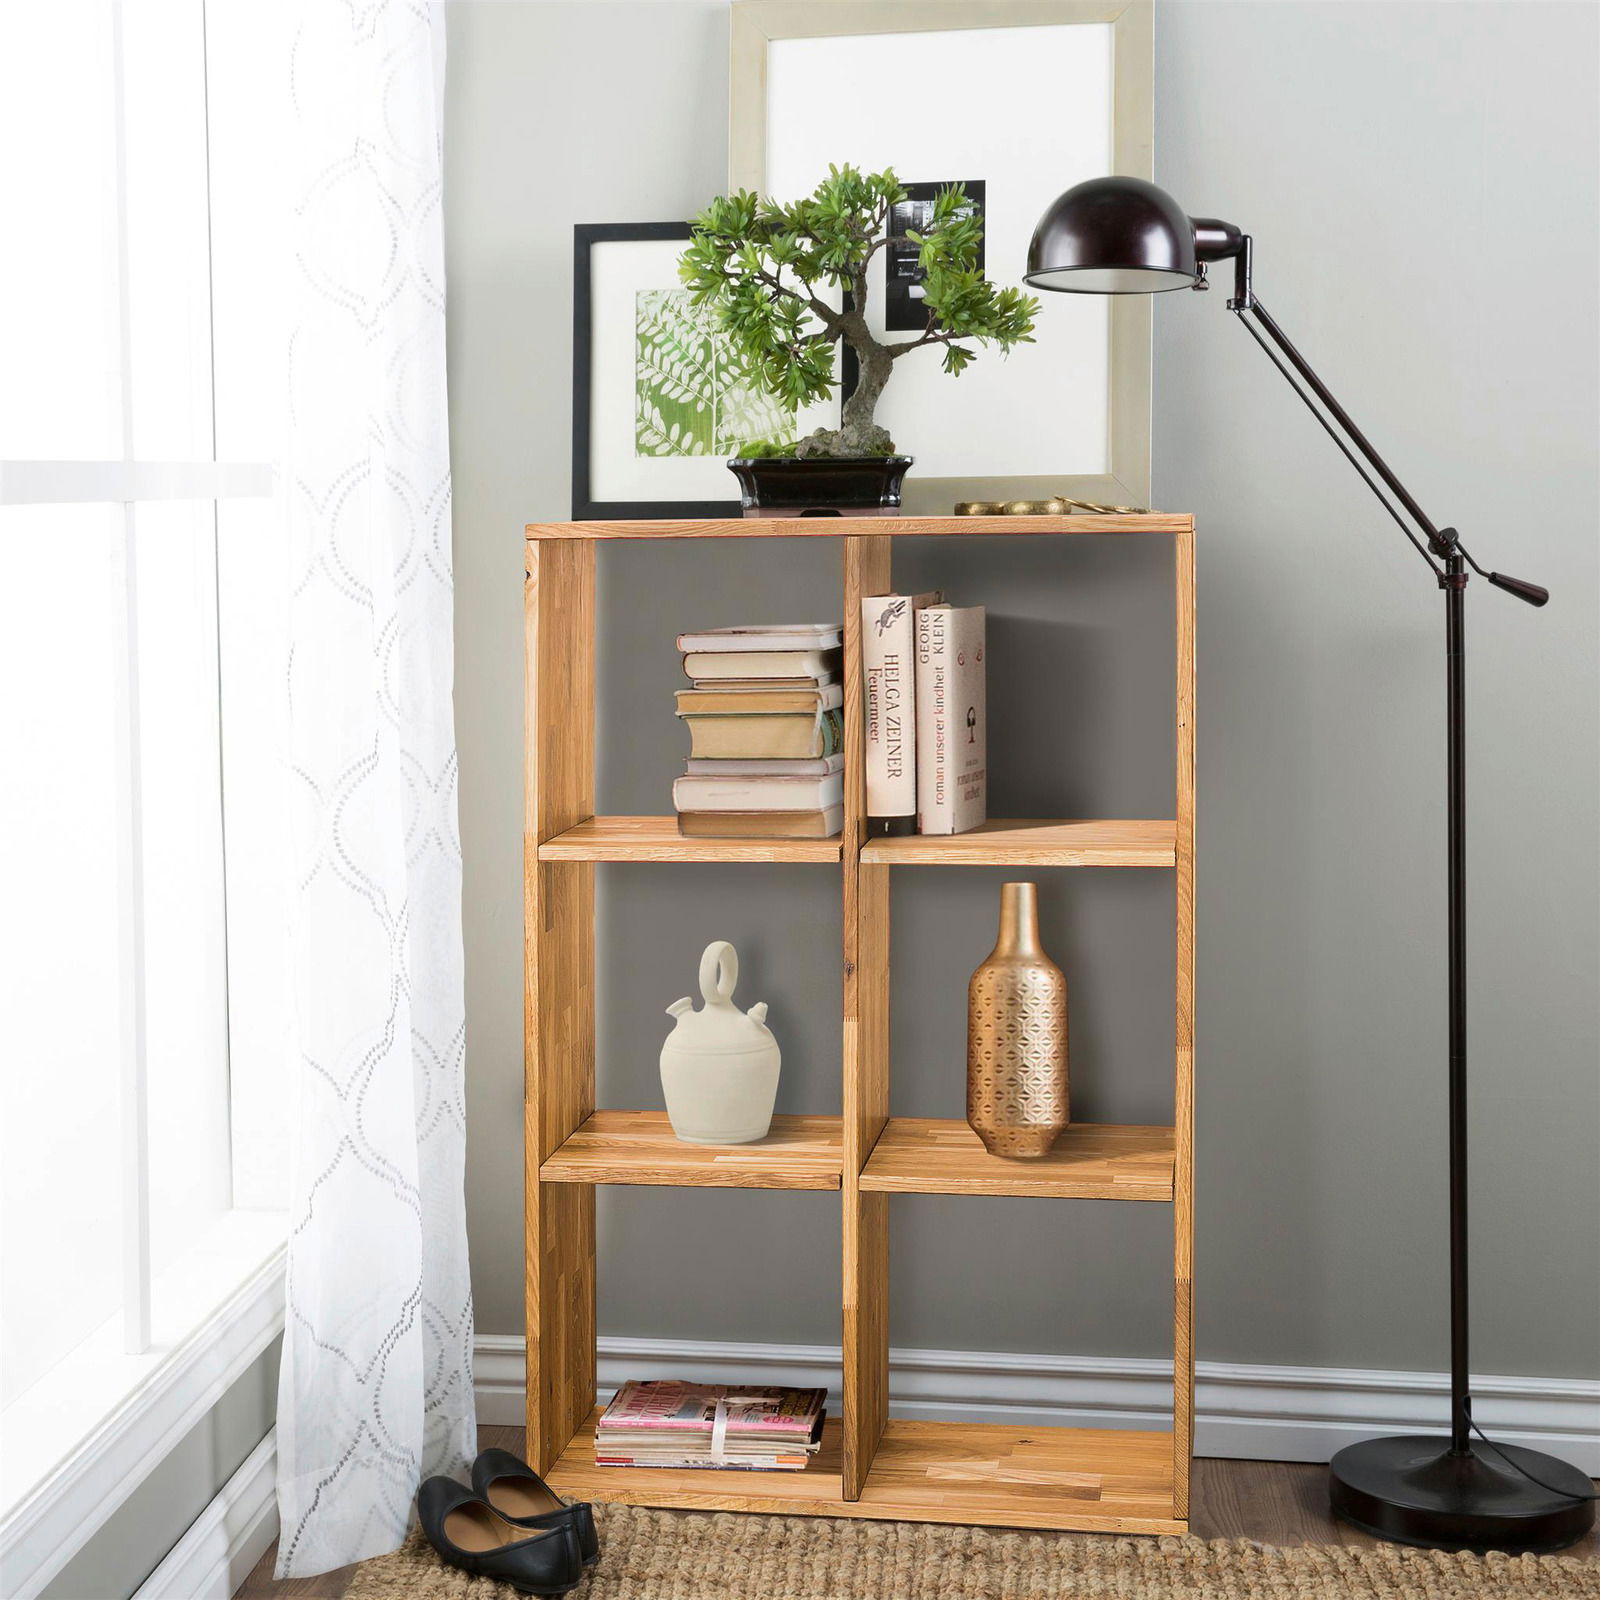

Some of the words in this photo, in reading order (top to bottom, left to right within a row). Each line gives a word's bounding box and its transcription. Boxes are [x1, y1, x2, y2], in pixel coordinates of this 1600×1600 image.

[919, 613, 930, 664] GEORG
[933, 613, 945, 655] KLEIN
[868, 668, 882, 744] Feuermeer
[884, 654, 900, 711] HELGA
[933, 666, 945, 715] kindheit
[886, 716, 902, 779] ZEINER
[935, 718, 945, 764] unserer
[936, 768, 945, 805] roman
